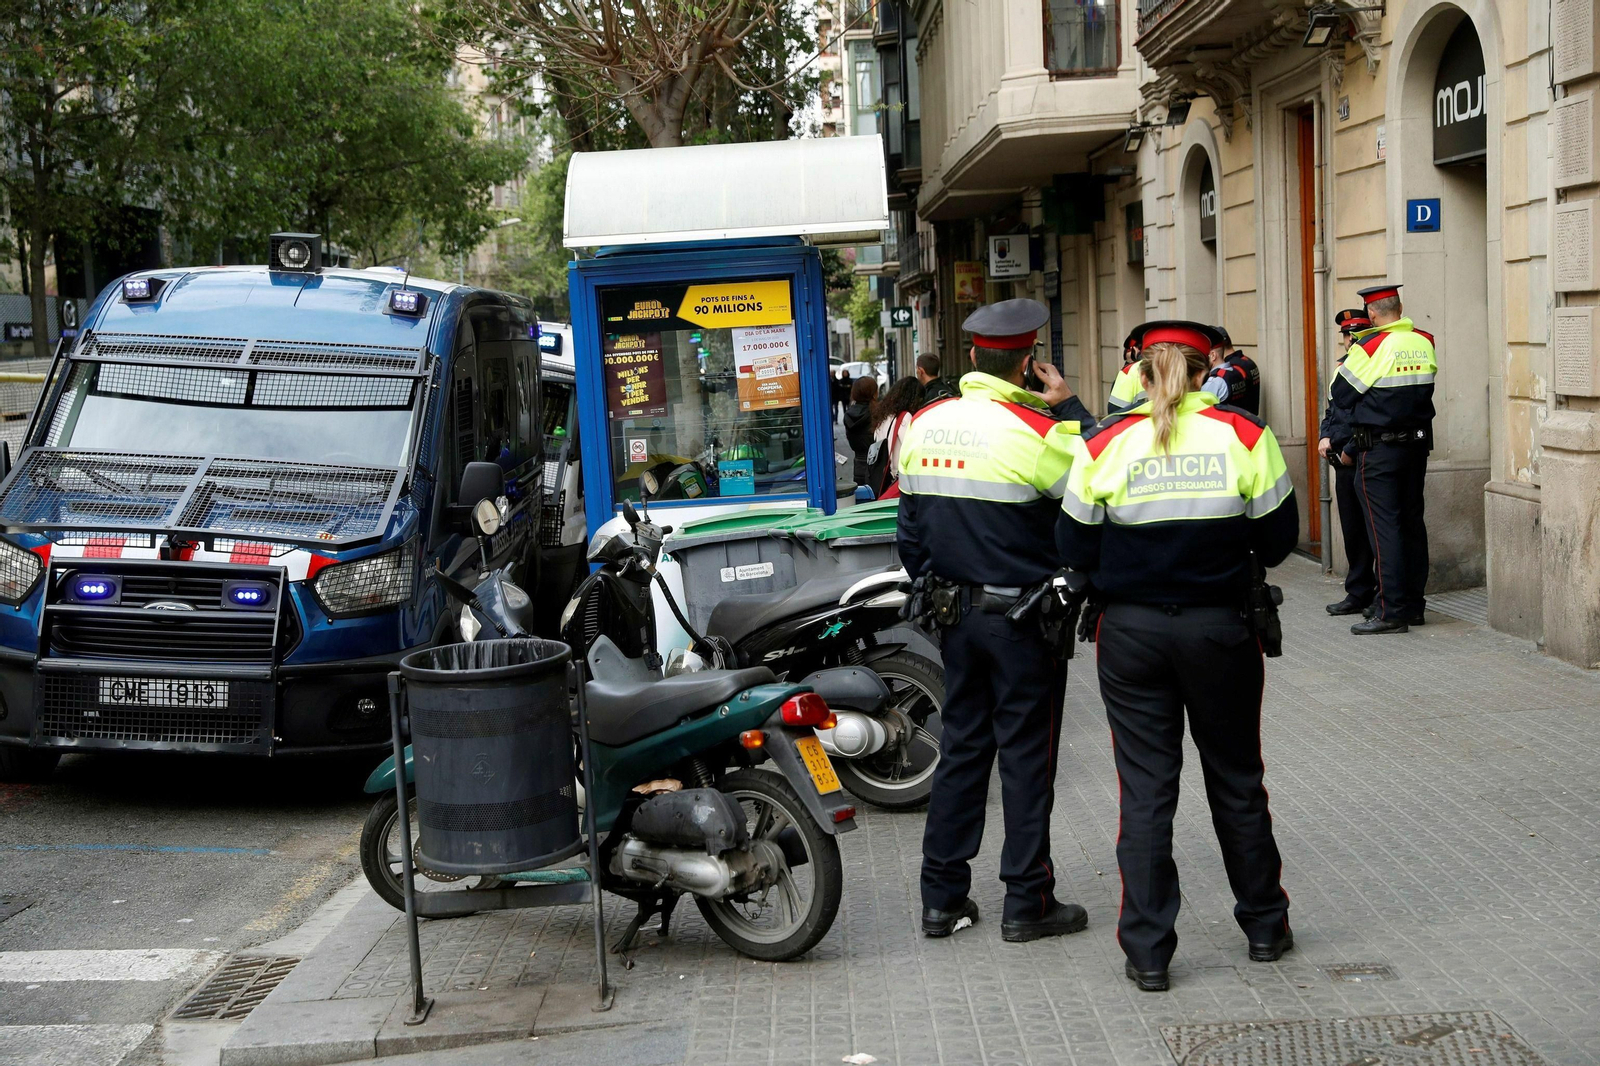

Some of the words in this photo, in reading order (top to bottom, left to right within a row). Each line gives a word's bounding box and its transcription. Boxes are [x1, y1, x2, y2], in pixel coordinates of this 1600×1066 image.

[1415, 204, 1432, 222] D
[627, 308, 667, 319] JACKPOT
[694, 305, 709, 315] 90
[712, 302, 763, 314] MILIONS
[1395, 350, 1428, 360] POLICIA
[626, 375, 640, 384] PER
[631, 389, 644, 398] PER
[621, 394, 650, 407] VENDRE
[922, 429, 989, 448] POLICIA
[921, 448, 946, 456] mossos
[1128, 456, 1224, 482] POLICIA
[1130, 482, 1165, 495] MOSSOS
[1166, 480, 1224, 490] D'ESQUADRA
[739, 565, 765, 574] Ajuntament
[745, 569, 769, 578] Barcelona
[762, 645, 796, 662] SH
[111, 680, 149, 703] CME
[166, 683, 215, 705] 1913
[806, 744, 819, 757] C6
[810, 757, 828, 771] 312
